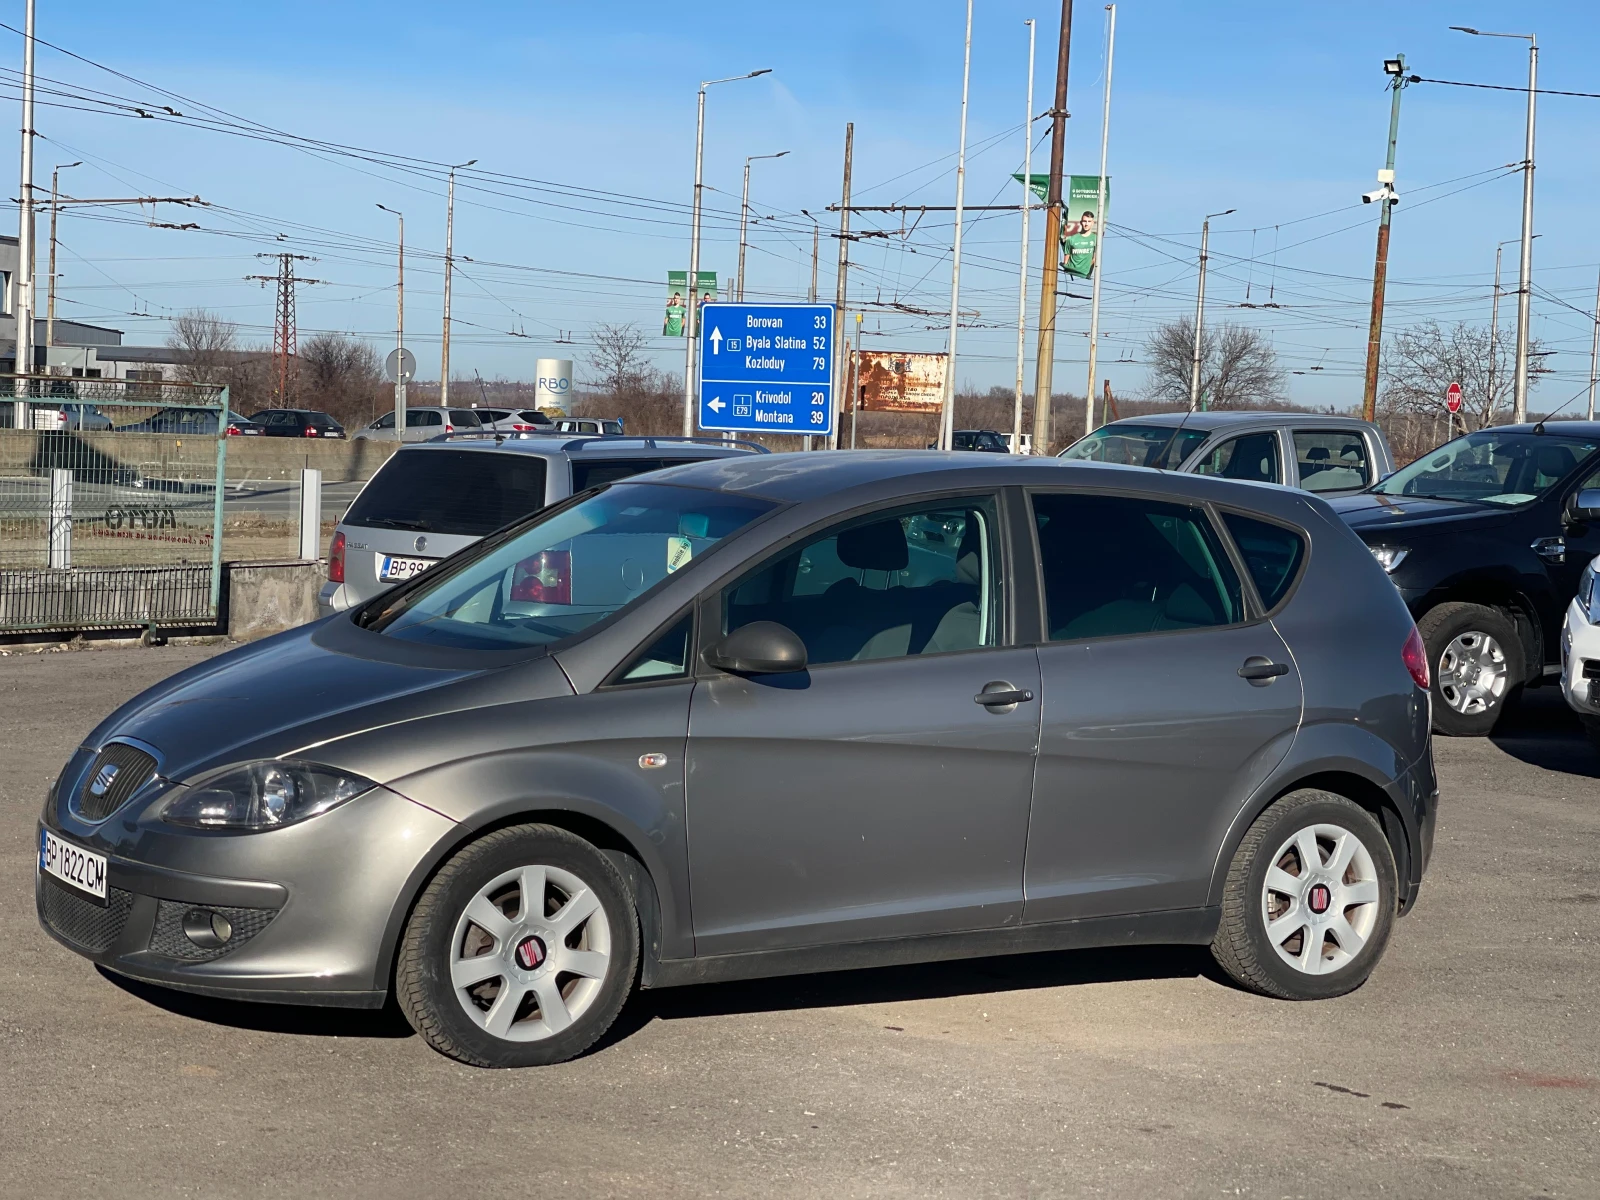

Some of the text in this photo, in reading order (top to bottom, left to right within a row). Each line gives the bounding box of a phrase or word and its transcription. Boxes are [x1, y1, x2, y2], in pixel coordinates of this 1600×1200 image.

[746, 315, 826, 329] Borovan 33
[730, 341, 738, 349] 15
[746, 336, 826, 351] Byala Slatina 52
[745, 356, 825, 372] Kozloduy 79
[538, 377, 569, 394] RBO
[755, 390, 824, 405] Krivodol 20
[1448, 392, 1460, 403] STOP
[736, 407, 748, 415] E79
[755, 409, 824, 424] Montana 39
[346, 542, 368, 550] PASSAT
[389, 561, 407, 576] BP
[46, 836, 104, 892] BP 1822 CM
